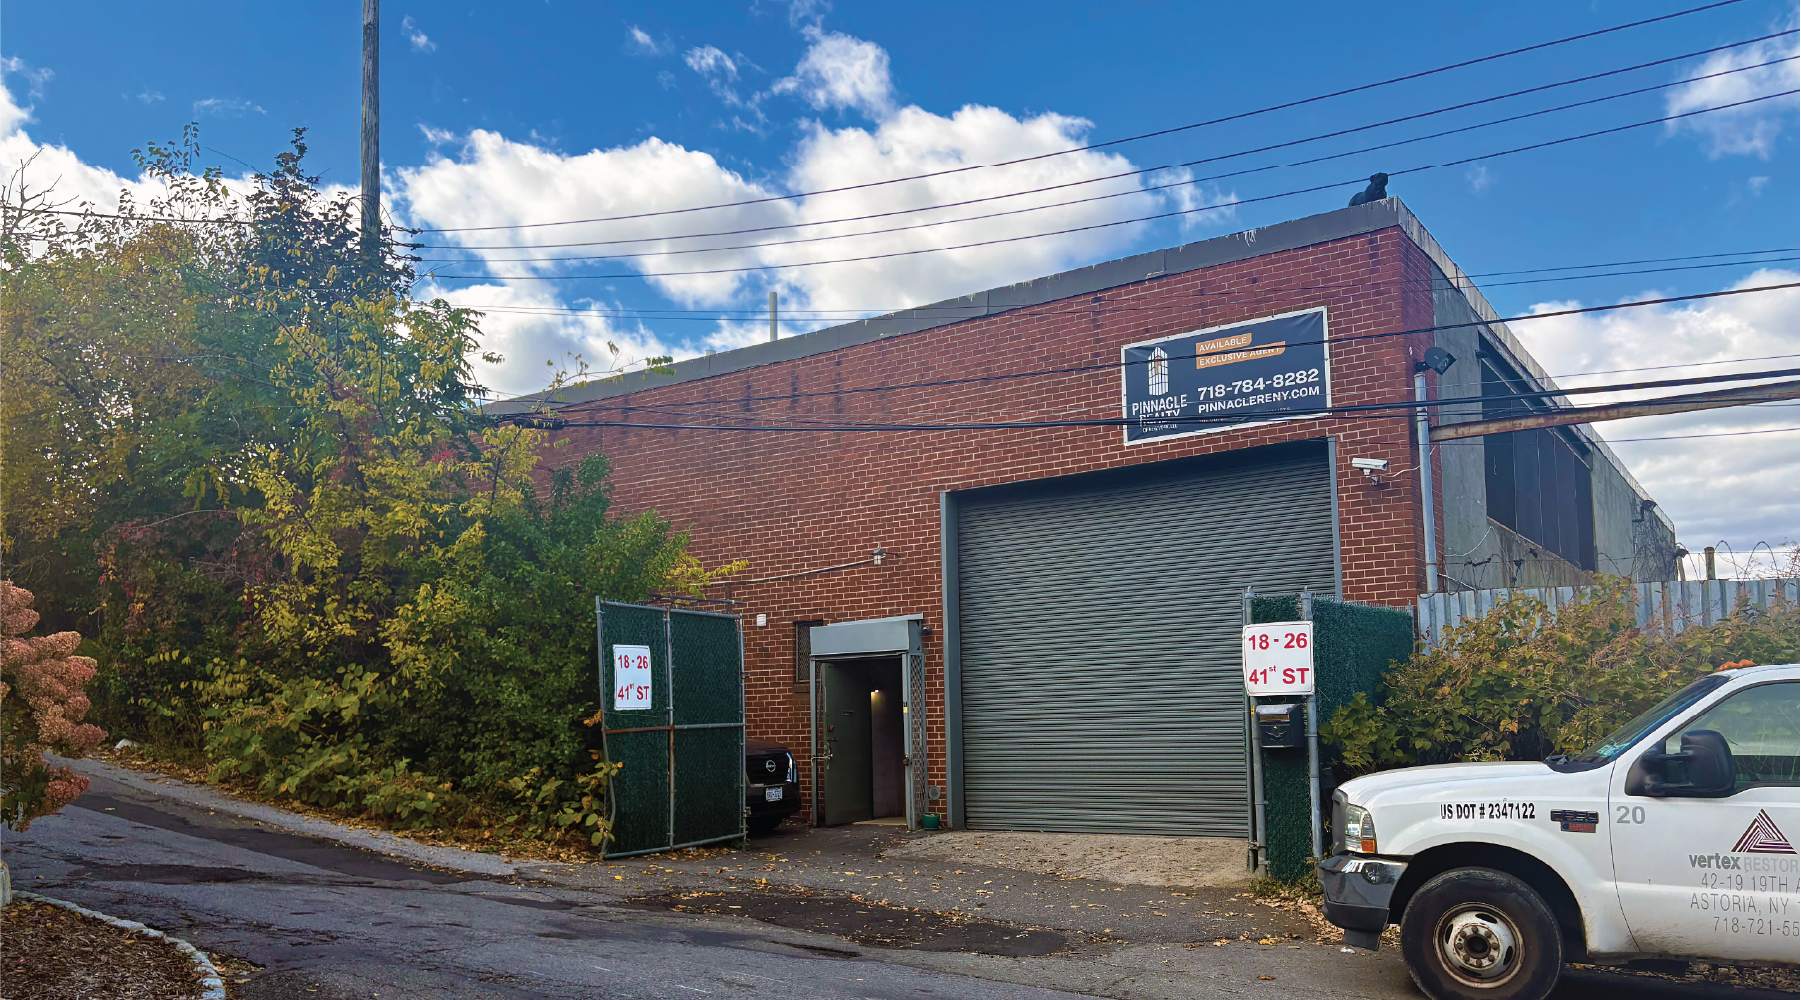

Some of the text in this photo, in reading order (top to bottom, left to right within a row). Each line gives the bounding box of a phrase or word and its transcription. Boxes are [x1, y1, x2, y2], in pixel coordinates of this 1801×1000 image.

[1199, 336, 1248, 352] AVAILABLE
[1199, 351, 1248, 366] EXCLUSIVE
[1198, 368, 1320, 401] 718-784-8282
[1132, 394, 1188, 416] PINNACLE
[1198, 386, 1320, 414] PINNACLERENY.COM
[1248, 633, 1270, 651] 18
[1283, 633, 1308, 649] 26
[618, 655, 629, 669] 18
[636, 655, 649, 670] 26
[1248, 664, 1310, 685] 41st ST
[636, 685, 650, 701] ST
[1440, 803, 1454, 820] US
[1456, 803, 1476, 820] DOT
[1479, 802, 1486, 820] #
[1488, 802, 1536, 820] 2347122
[1616, 806, 1646, 825] 20
[1688, 852, 1741, 870] vertex
[1701, 872, 1743, 891] 42-19
[1751, 875, 1788, 893] 19TH
[1690, 892, 1789, 916] ASTORIA, NY
[1713, 916, 1800, 937] 718-721-55
